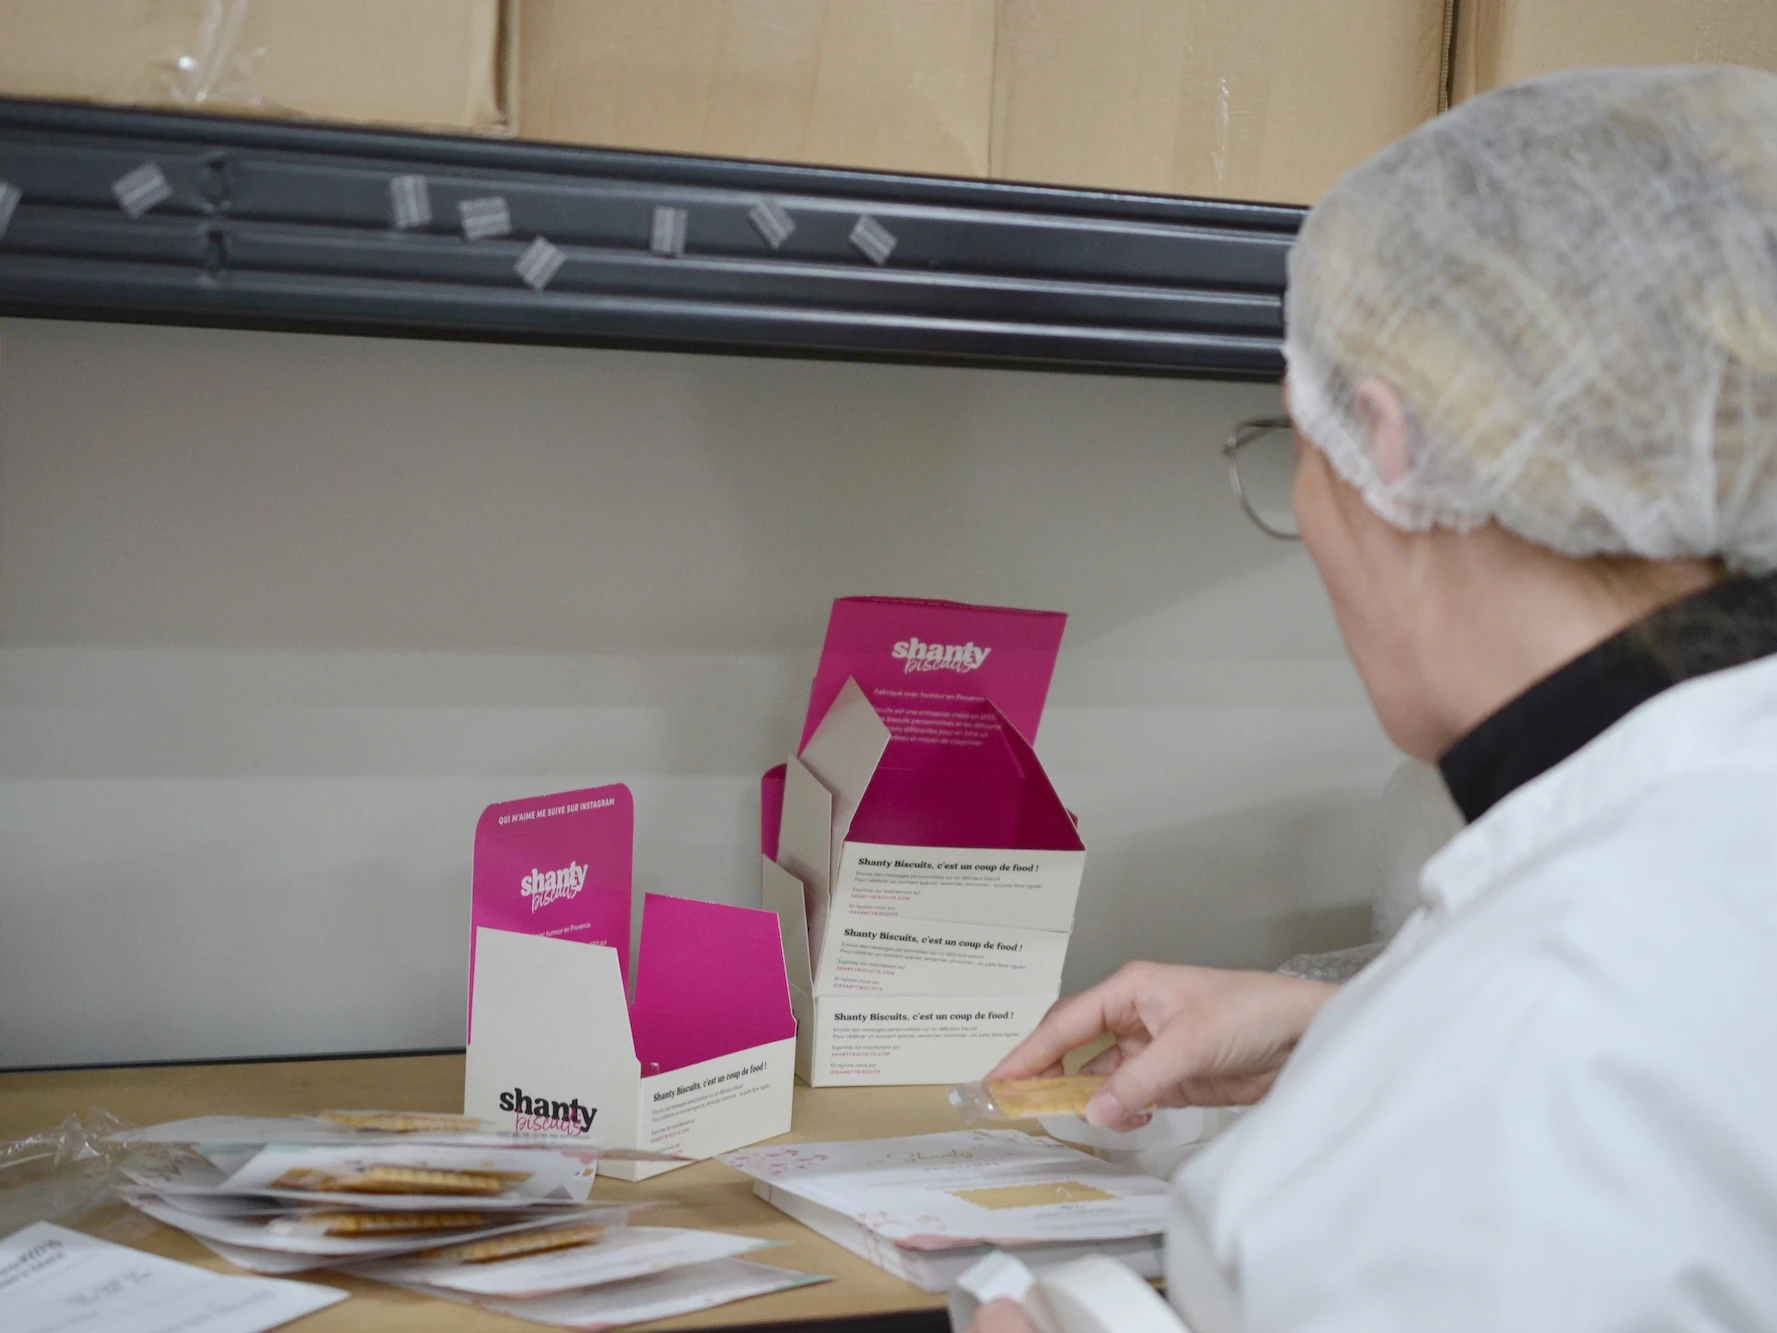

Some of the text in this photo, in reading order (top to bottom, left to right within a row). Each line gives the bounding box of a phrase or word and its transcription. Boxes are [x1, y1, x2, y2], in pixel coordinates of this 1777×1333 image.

[892, 637, 992, 670] shanty
[498, 798, 615, 826] QUI M'AIME ME SUIVE SUR INSTAGRAM
[520, 860, 589, 897] shanty
[858, 858, 892, 868] Shanty
[894, 860, 934, 870] Biscuits,
[937, 861, 958, 870] c'est
[974, 864, 998, 872] coup
[1012, 864, 1034, 872] food
[844, 928, 878, 941] Shanty
[880, 932, 919, 944] Biscuits,
[922, 936, 943, 945] c'est
[958, 940, 982, 950] coup
[983, 940, 995, 950] de
[996, 942, 1018, 952] food
[834, 1012, 868, 1022] Shanty
[870, 1012, 910, 1022] Biscuits,
[912, 1012, 934, 1020] c'est
[950, 1013, 973, 1022] coup
[974, 1011, 986, 1020] de
[988, 1010, 1009, 1020] food
[653, 1088, 676, 1102] Shanty
[676, 1081, 702, 1096] Biscuits,
[703, 1077, 717, 1088] c'est
[718, 1075, 726, 1083] un
[726, 1069, 741, 1080] coup
[741, 1066, 749, 1076] de
[750, 1061, 764, 1074] food
[499, 1087, 598, 1133] shanty
